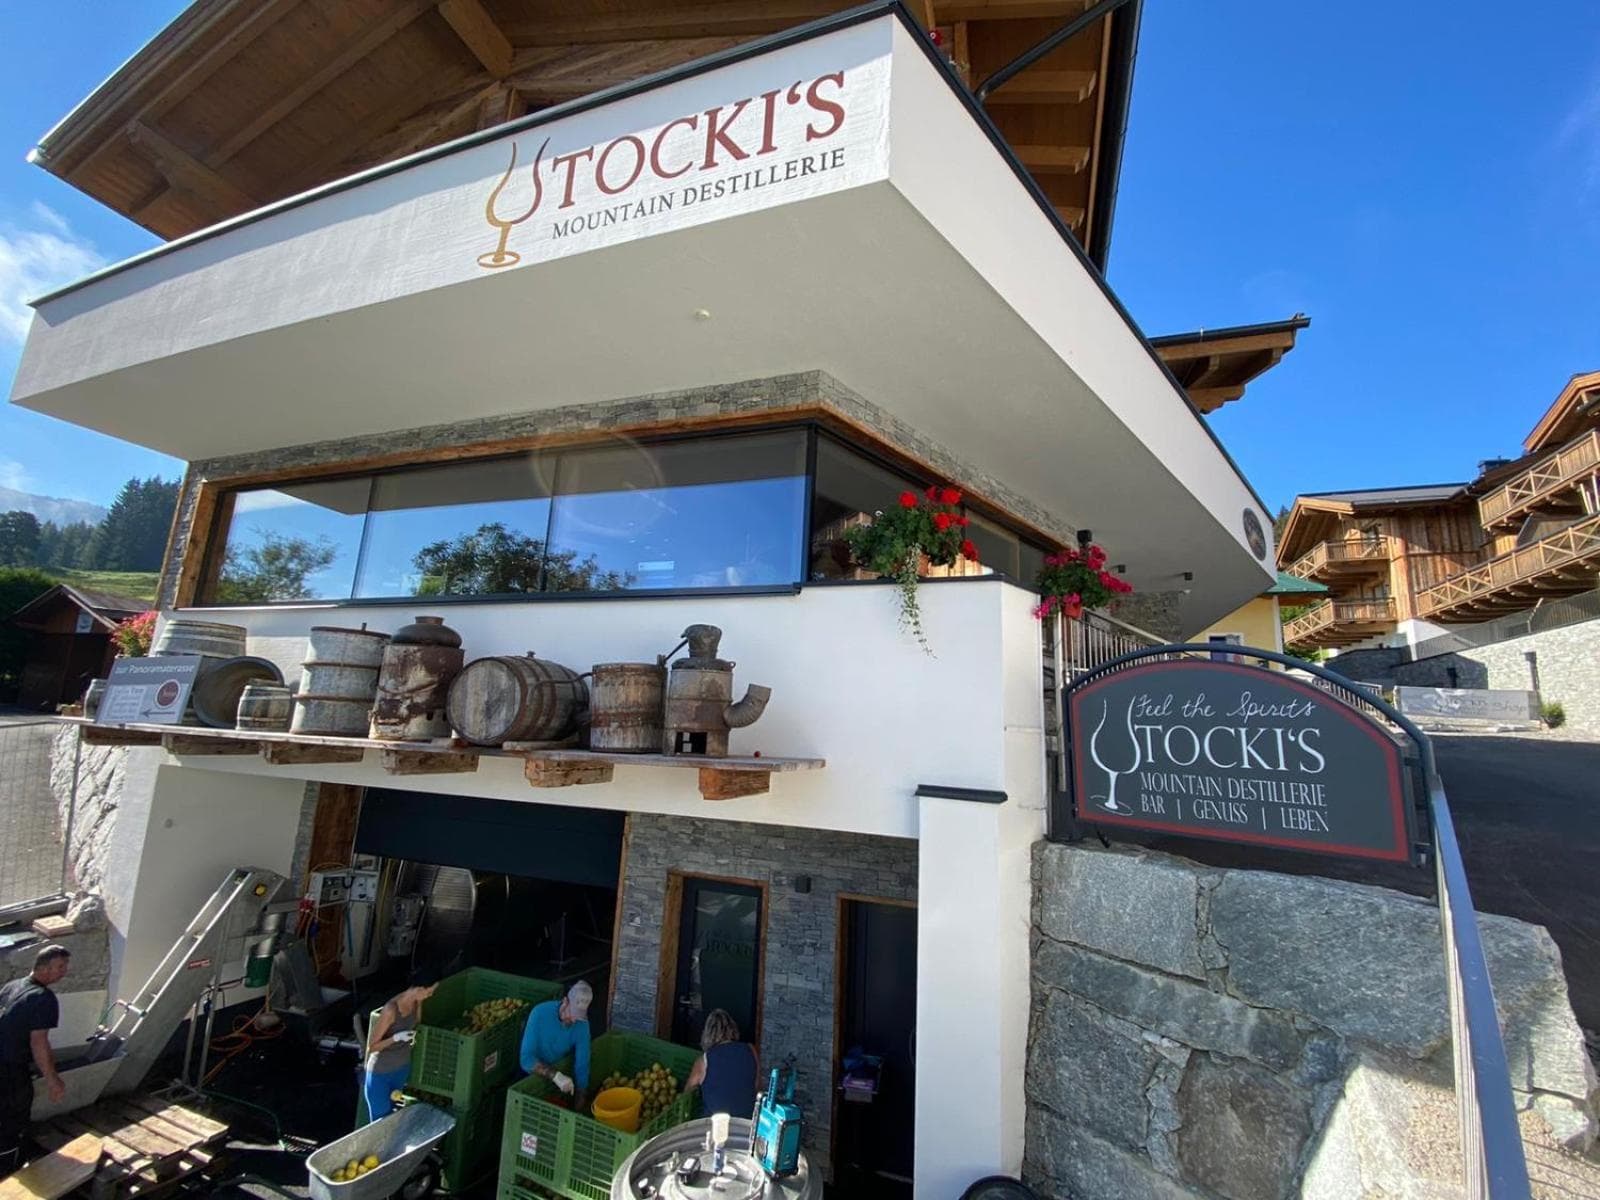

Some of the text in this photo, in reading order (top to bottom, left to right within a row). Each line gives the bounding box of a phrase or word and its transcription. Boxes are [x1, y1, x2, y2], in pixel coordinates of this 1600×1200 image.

[552, 148, 846, 240] MOUNTAIN DESTILLERIE
[1136, 691, 1317, 723] Feel the Spirits
[1140, 771, 1328, 807] MOUNTAIN DESTILLERIE
[1141, 794, 1166, 815] BAR
[1193, 799, 1249, 824] GENUSS
[1280, 807, 1329, 832] LEBEN
